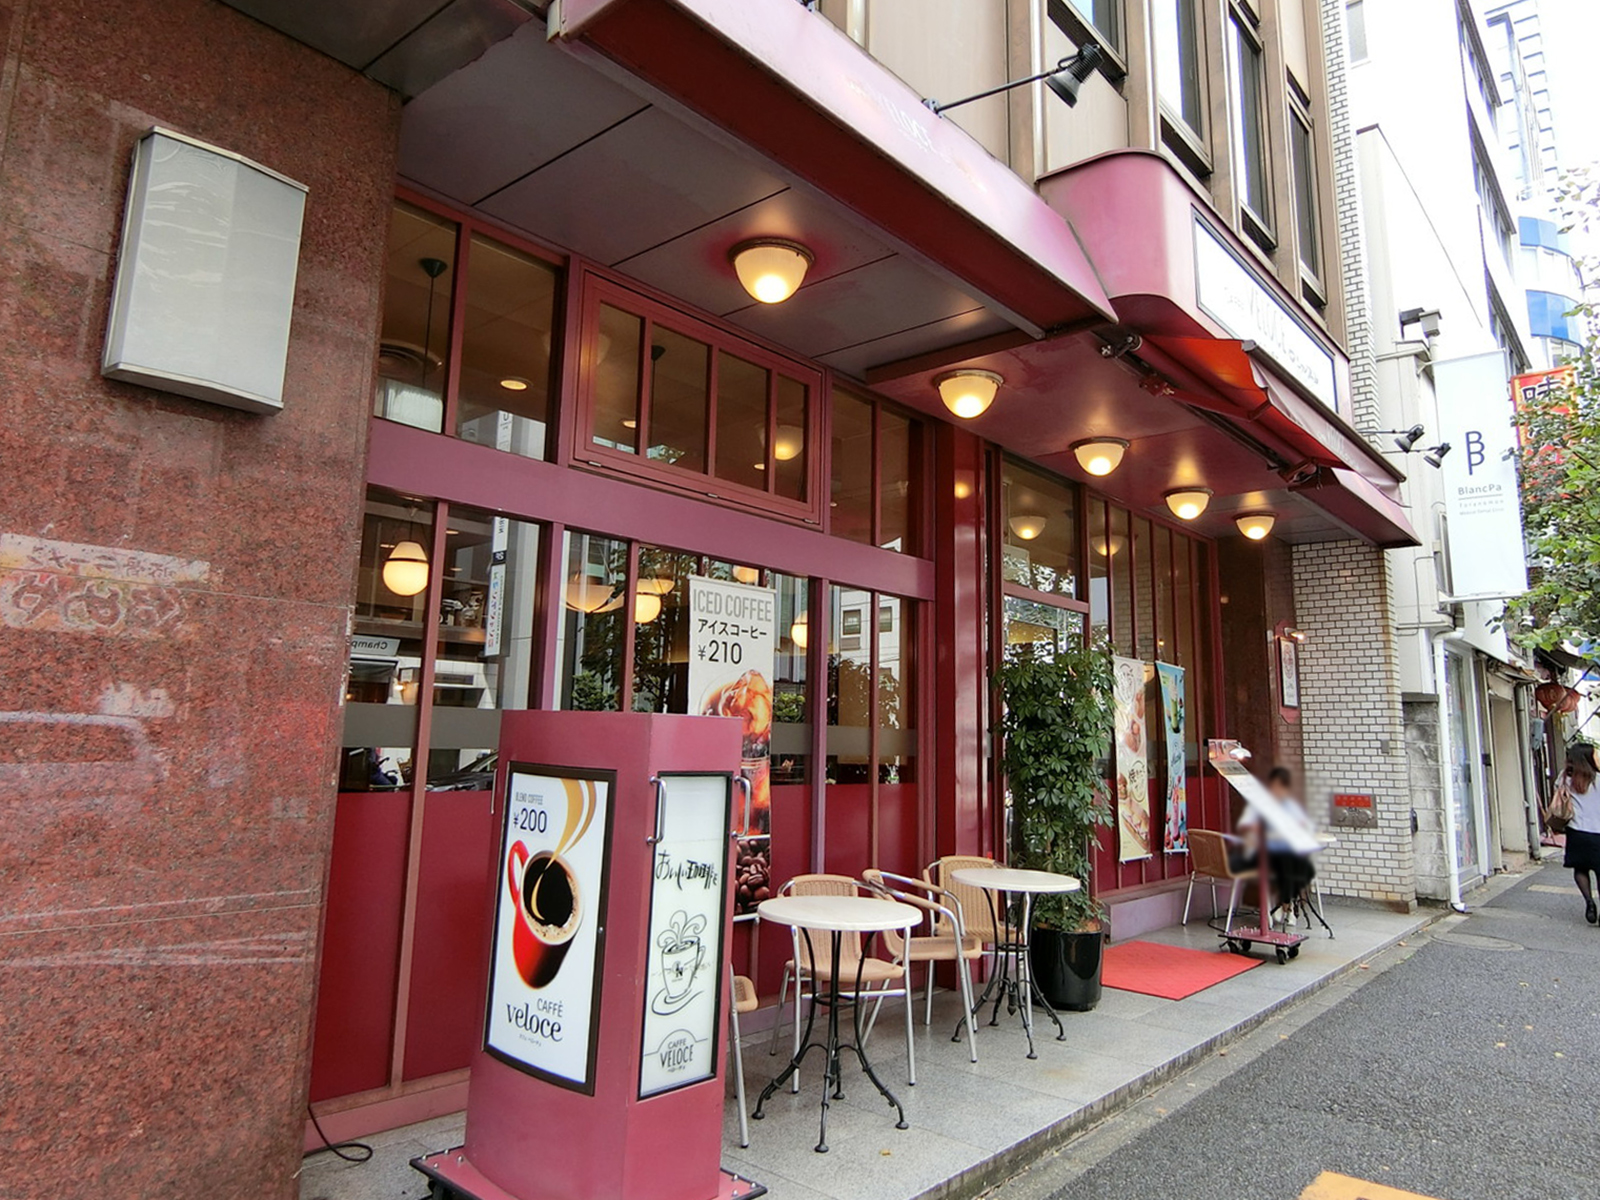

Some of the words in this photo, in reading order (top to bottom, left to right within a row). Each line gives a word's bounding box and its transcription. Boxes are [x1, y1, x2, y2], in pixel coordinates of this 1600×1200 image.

[1458, 483, 1502, 496] BlancPa
[693, 588, 723, 616] ICED
[725, 594, 772, 622] COFFEE
[697, 617, 767, 640] アイスコーヒー
[697, 639, 742, 665] ¥210
[513, 807, 548, 833] ¥200
[506, 1002, 563, 1042] veloce
[660, 1044, 694, 1068] VELOCE
